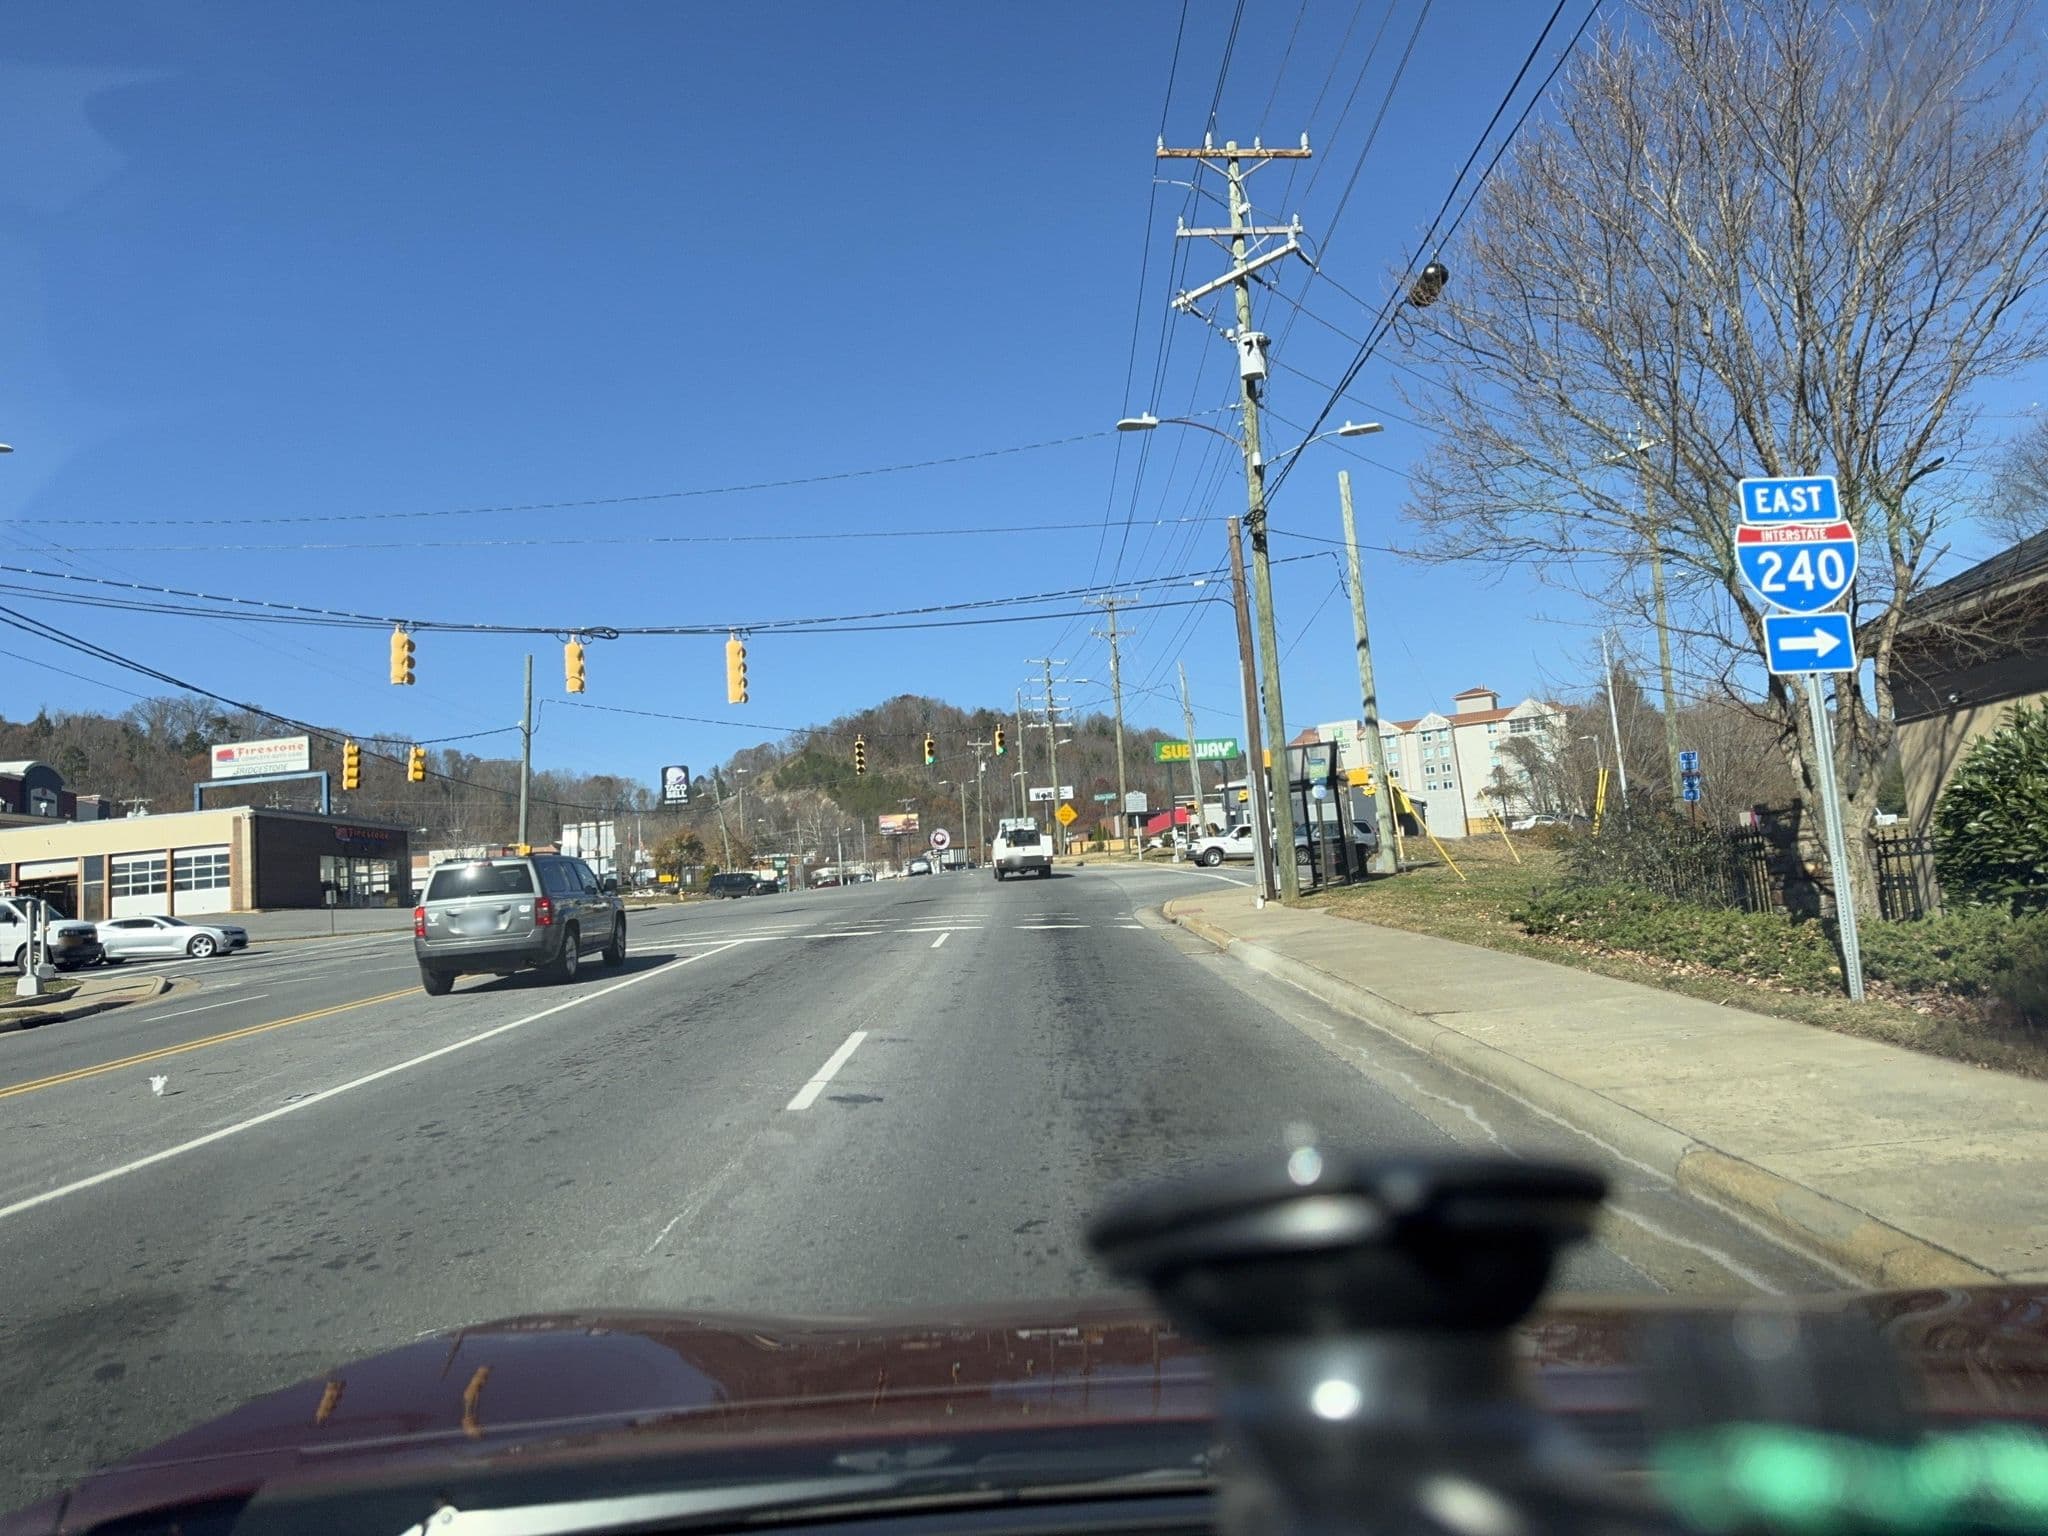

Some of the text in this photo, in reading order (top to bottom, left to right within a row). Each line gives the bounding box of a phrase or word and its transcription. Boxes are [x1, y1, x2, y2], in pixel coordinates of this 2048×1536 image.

[1755, 486, 1821, 513] EAST
[1761, 528, 1828, 542] INTERSTATE
[1757, 548, 1845, 592] 240
[236, 743, 304, 757] Firestone
[1160, 741, 1234, 760] SUBWAY
[233, 763, 288, 775] BRIDGESTONE
